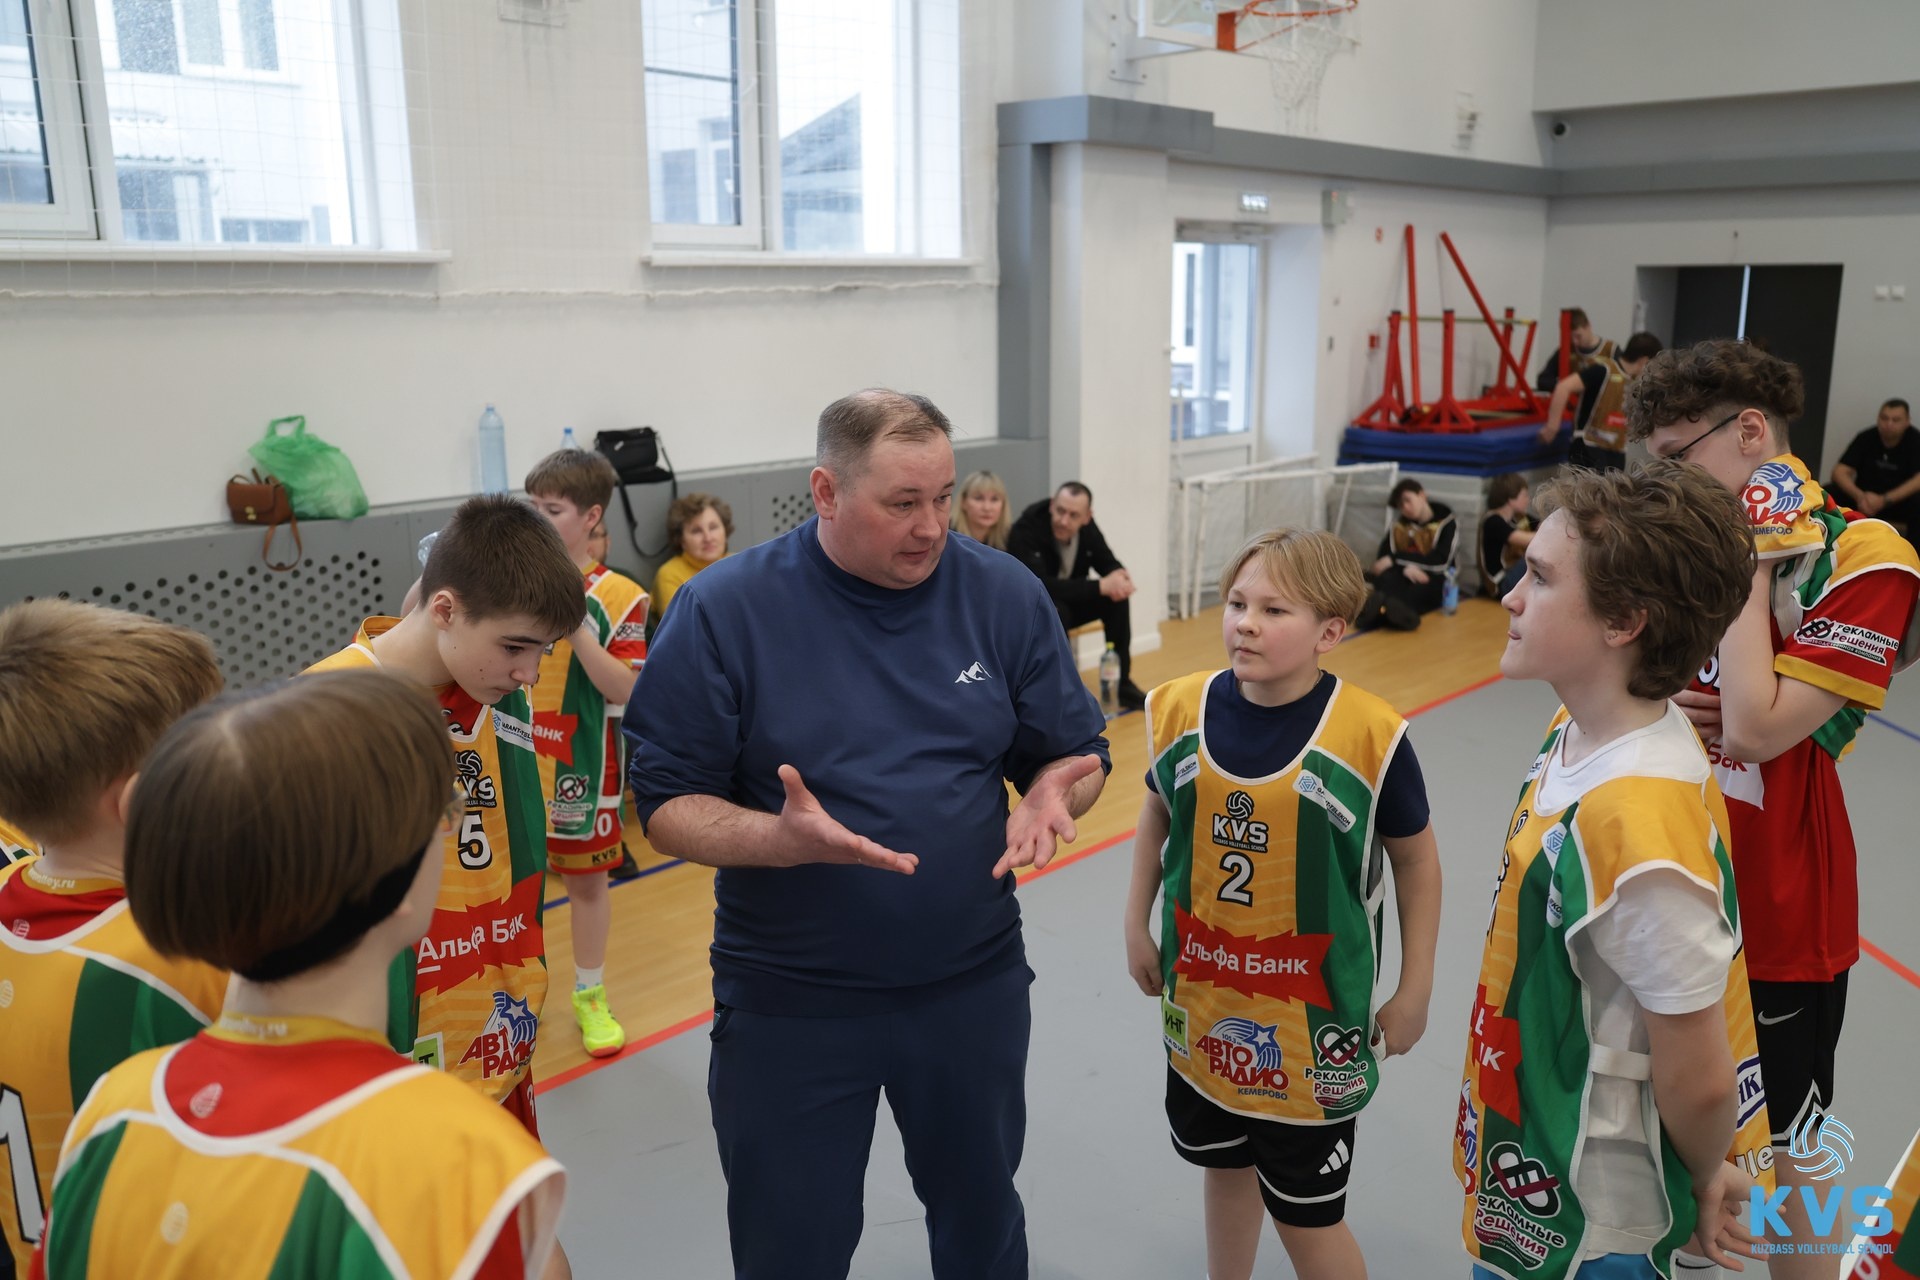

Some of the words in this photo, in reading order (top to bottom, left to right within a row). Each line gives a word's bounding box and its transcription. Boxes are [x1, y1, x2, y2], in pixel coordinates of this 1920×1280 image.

[1831, 632, 1885, 655] Решения
[532, 724, 564, 743] анк
[457, 777, 496, 801] VS
[458, 811, 492, 870] 5
[1213, 814, 1268, 845] KVS
[1217, 852, 1253, 907] 2
[1244, 952, 1310, 975] Банк
[1195, 1034, 1254, 1067] АВТО
[1209, 1056, 1290, 1091] РАДИО
[1305, 1062, 1367, 1081] Реклаые
[1237, 1087, 1288, 1101] КЕМЕРОВО
[1477, 1186, 1565, 1247] екламные
[1476, 1208, 1547, 1258] Решения
